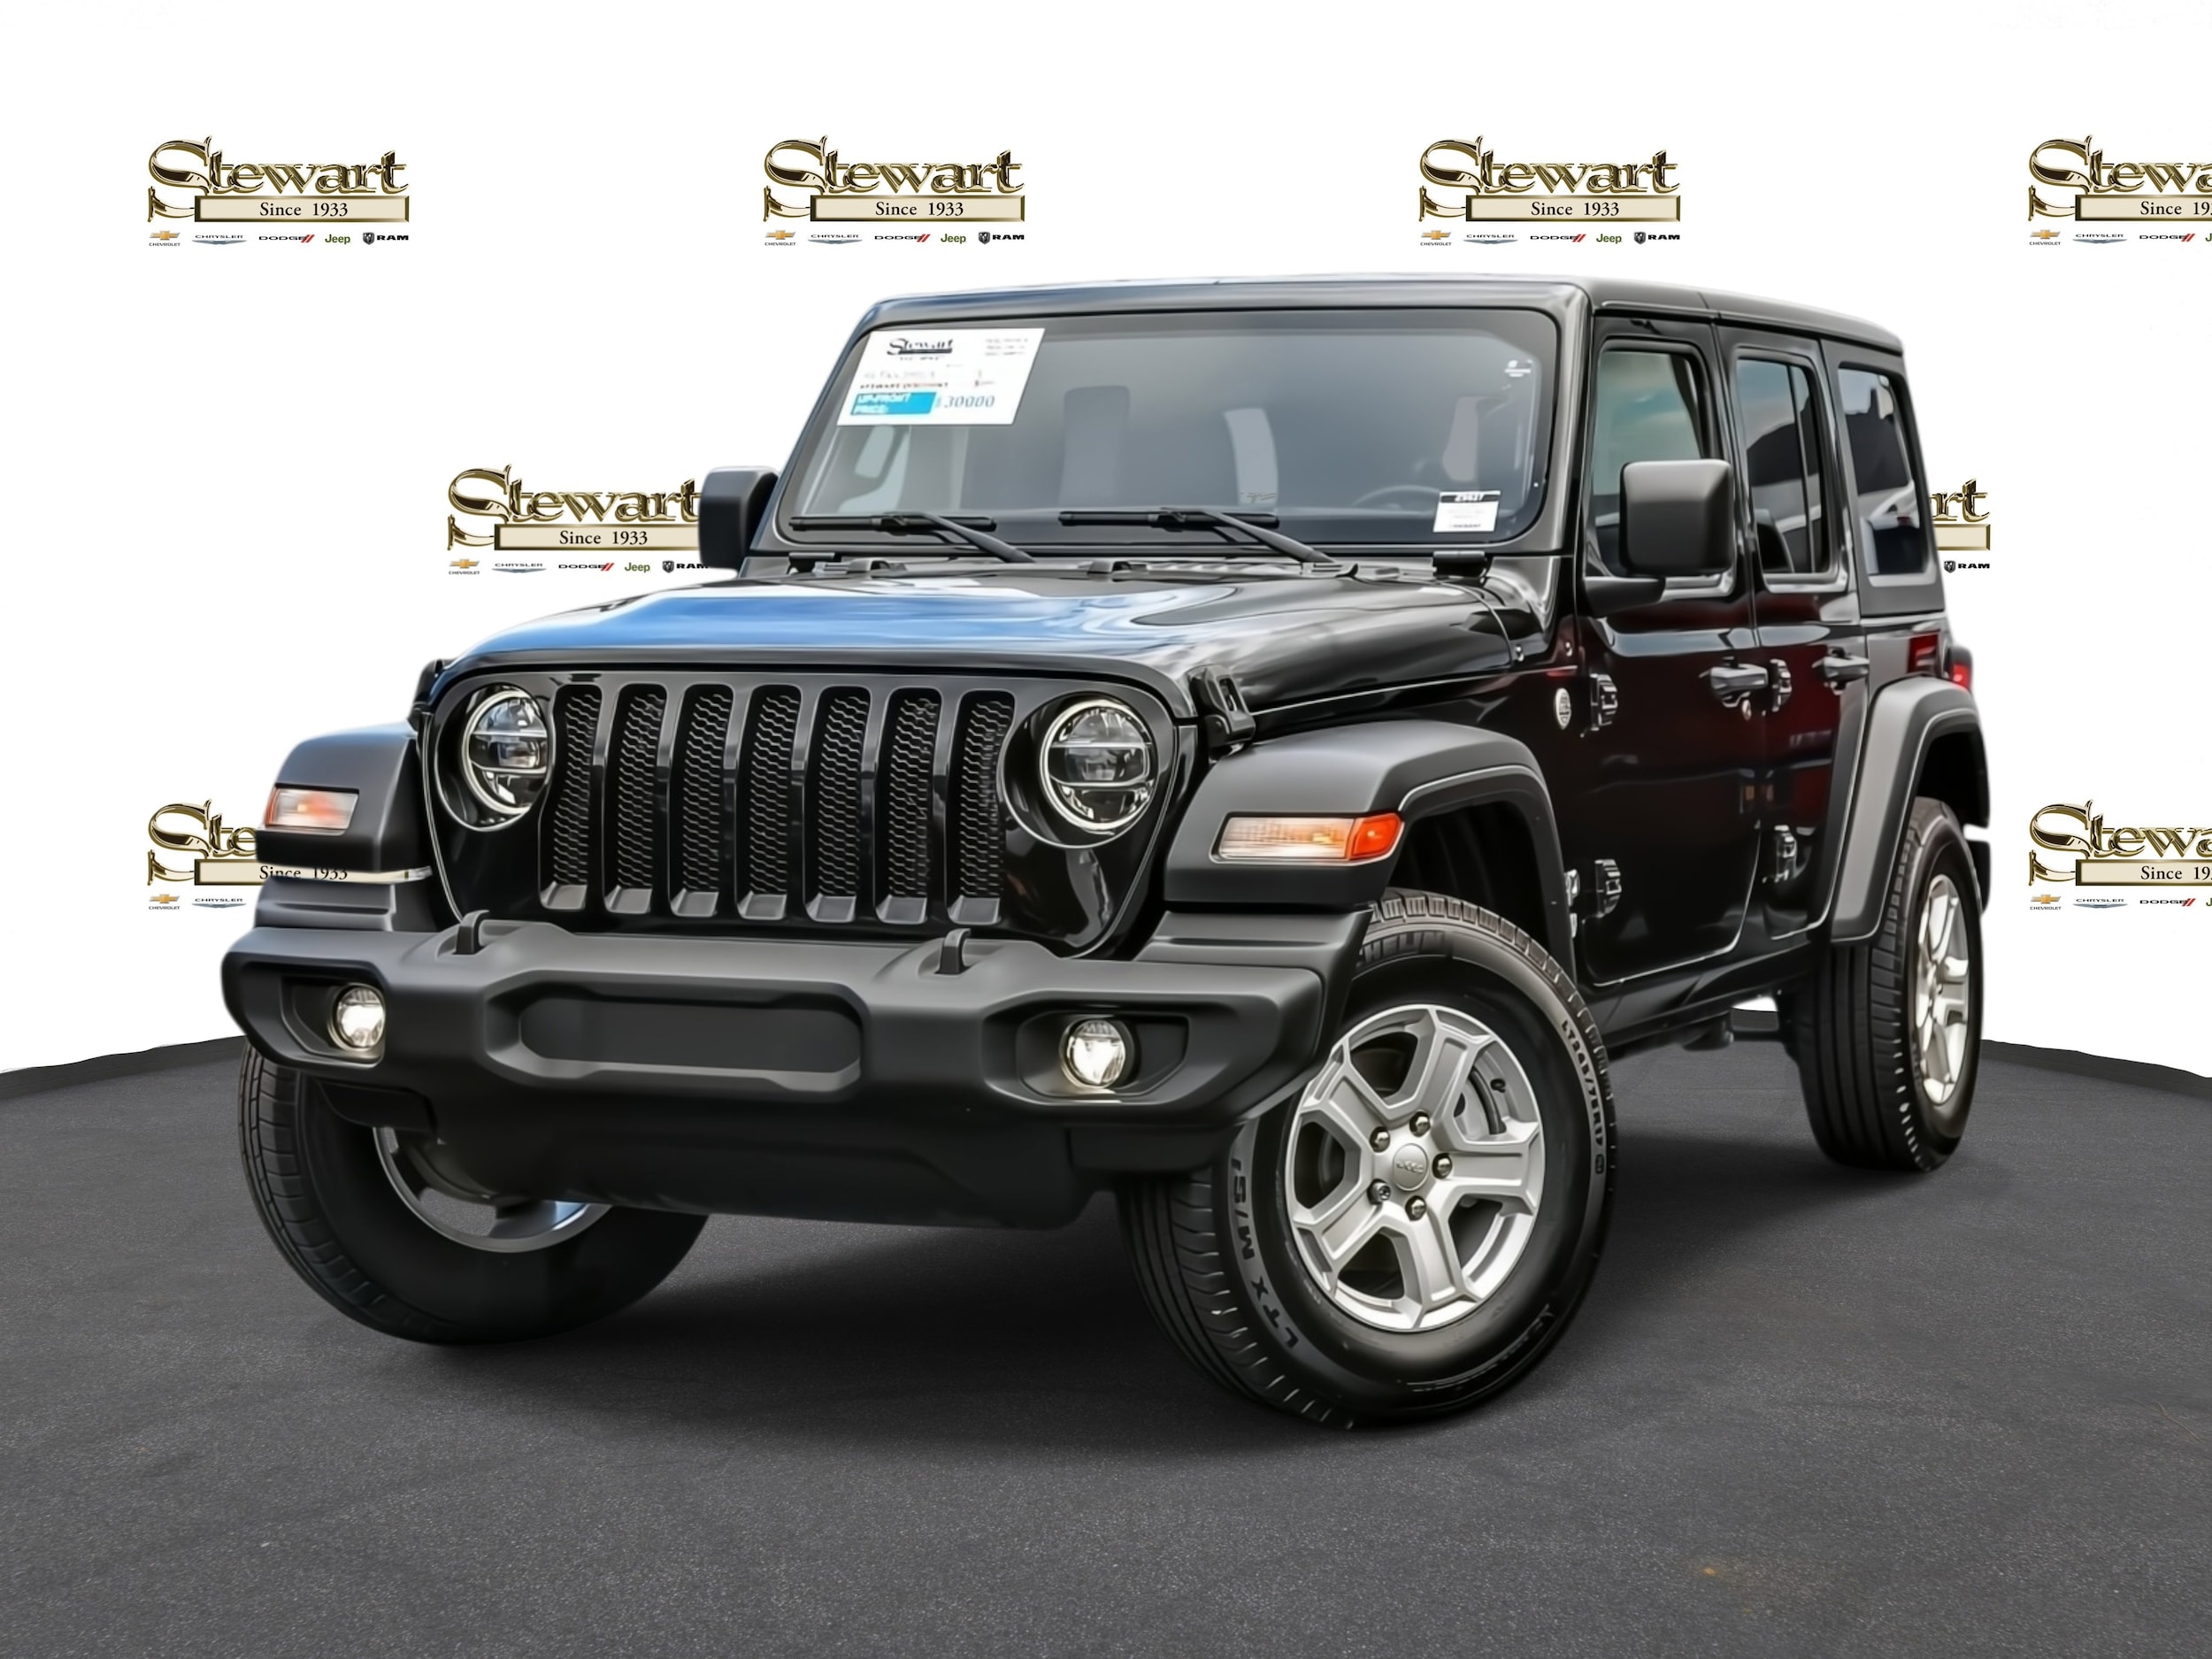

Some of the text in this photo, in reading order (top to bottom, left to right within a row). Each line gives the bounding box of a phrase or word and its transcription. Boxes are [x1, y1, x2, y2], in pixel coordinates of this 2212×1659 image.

[148, 135, 409, 221] Stewart
[764, 135, 1025, 221] Stewart
[1419, 135, 1680, 221] Stewart
[259, 202, 349, 217] Since 1933
[875, 202, 964, 217] Since 1933
[1531, 202, 1620, 217] Since 1933
[2139, 201, 2212, 215] Since 19
[325, 233, 351, 244] Jeep
[941, 233, 967, 244] Jeep
[1596, 233, 1623, 244] Jeep
[448, 464, 700, 549] Stewart
[559, 530, 649, 545] Since 1933
[625, 561, 651, 572] Jeep
[2140, 866, 2212, 880] Since 19
[1249, 1275, 1299, 1349] LTX
